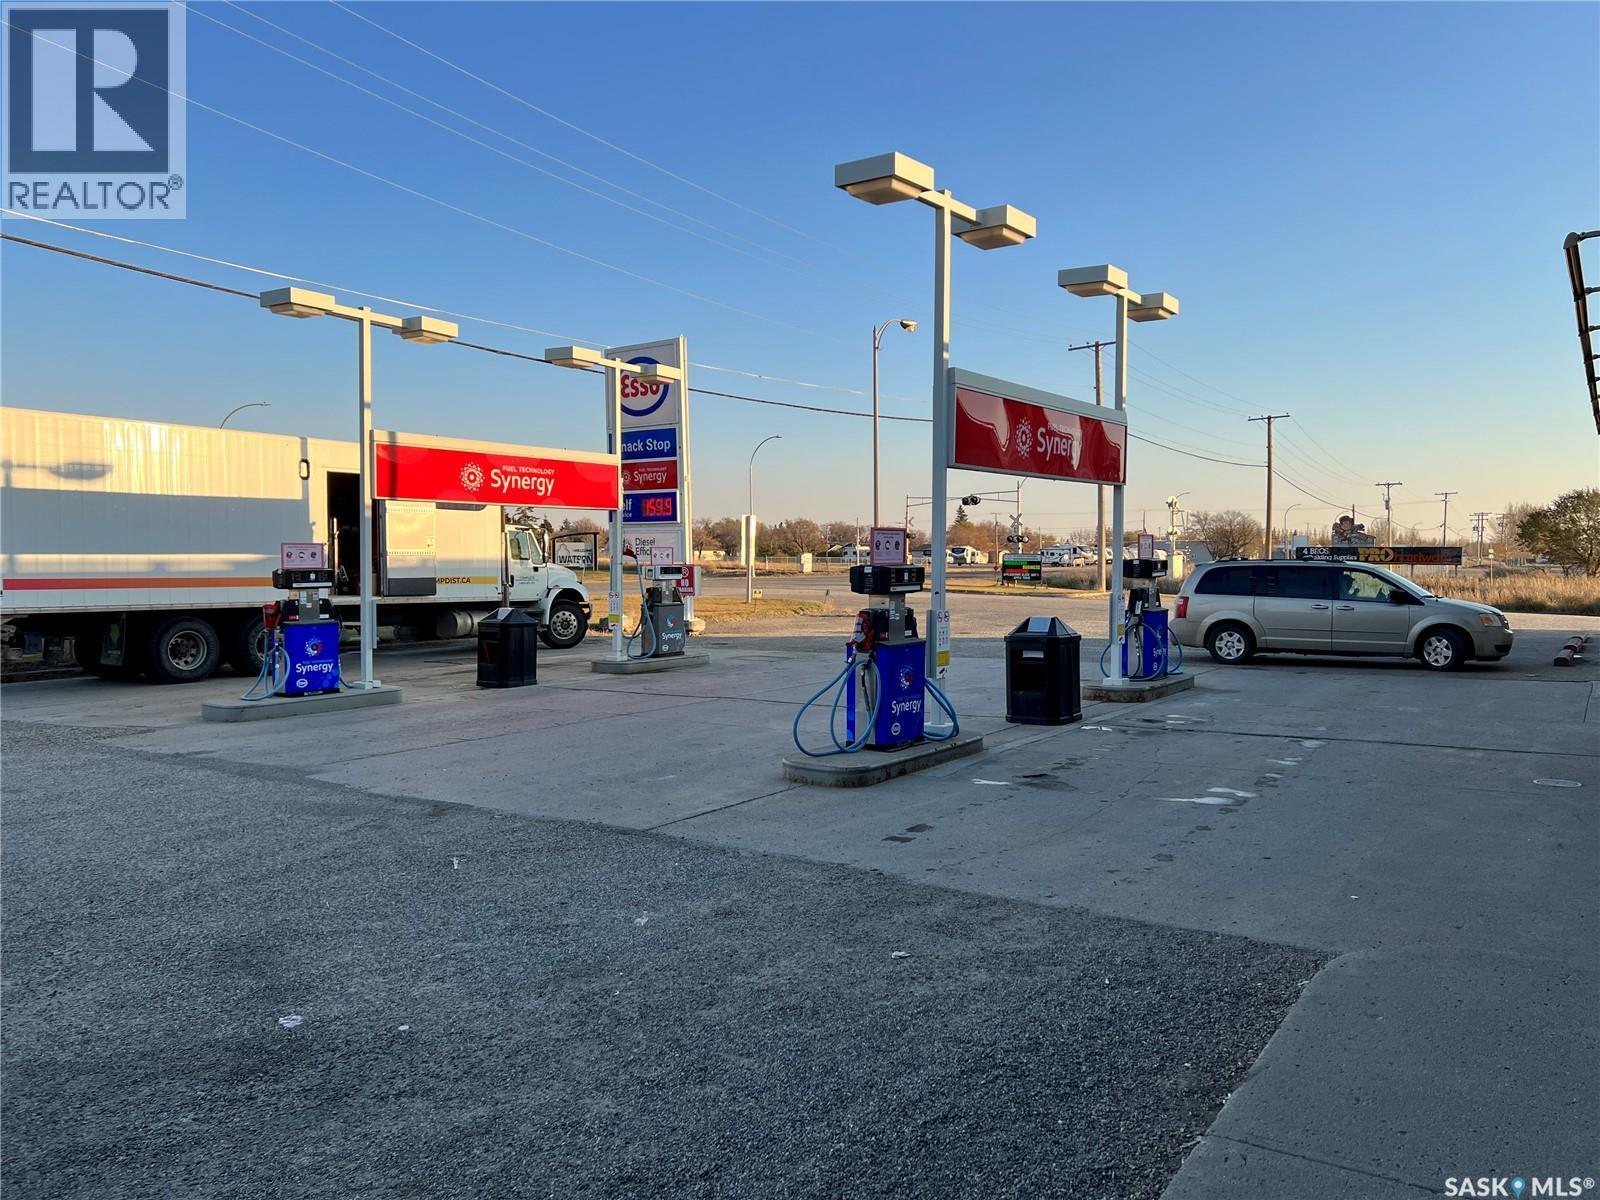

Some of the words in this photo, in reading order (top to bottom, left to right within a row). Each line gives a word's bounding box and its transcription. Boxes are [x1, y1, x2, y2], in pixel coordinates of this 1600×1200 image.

[622, 440, 643, 452] nack
[646, 439, 671, 452] Stop
[519, 466, 555, 475] TECHNOLOGY
[634, 470, 667, 484] Synergy
[490, 469, 555, 496] Synergy
[635, 538, 656, 546] Diesel
[559, 555, 593, 564] WATSON
[1359, 547, 1394, 562] PRO
[296, 663, 334, 675] Synergy
[892, 700, 921, 716] Synergy
